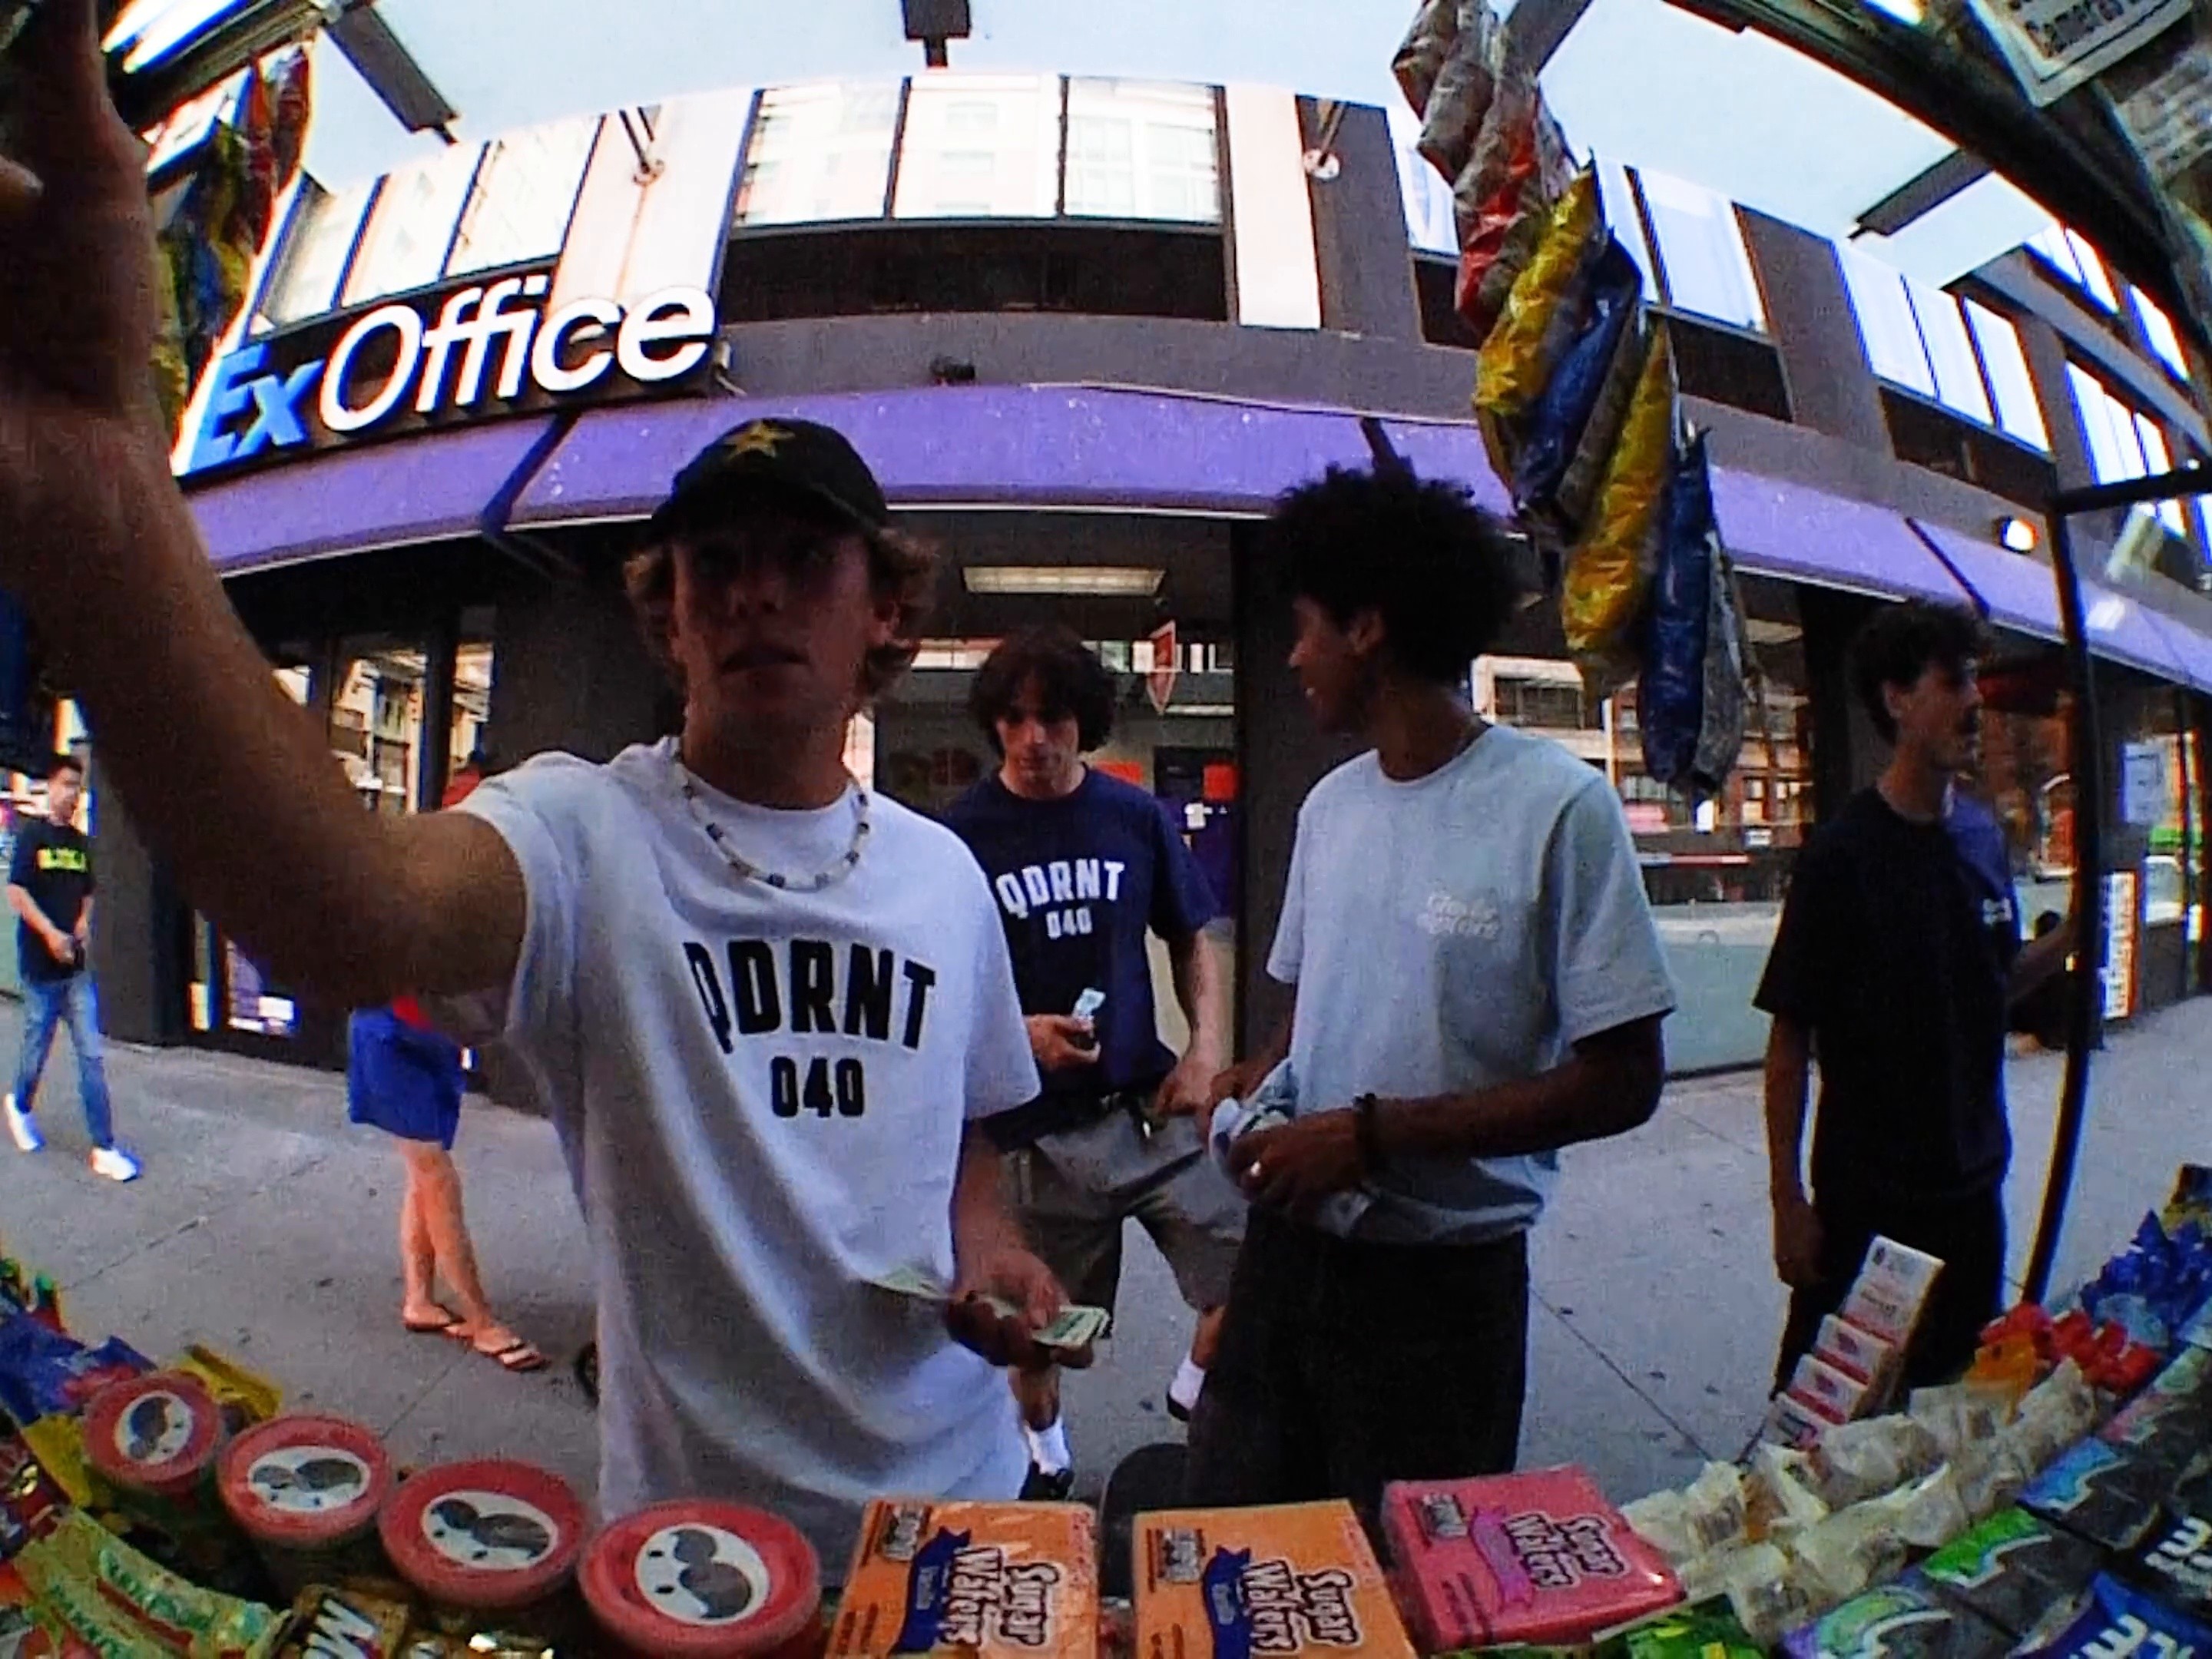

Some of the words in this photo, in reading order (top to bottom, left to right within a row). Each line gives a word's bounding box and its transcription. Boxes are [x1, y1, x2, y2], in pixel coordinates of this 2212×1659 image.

[318, 273, 717, 432] Office
[995, 858, 1125, 919] QDRNT
[1045, 906, 1093, 940] 040
[770, 1055, 865, 1118] 040
[939, 1546, 1002, 1645] Wafers
[1001, 1561, 1061, 1646] Sugar
[1241, 1558, 1300, 1651] Wafers
[1298, 1569, 1360, 1645] Sugar
